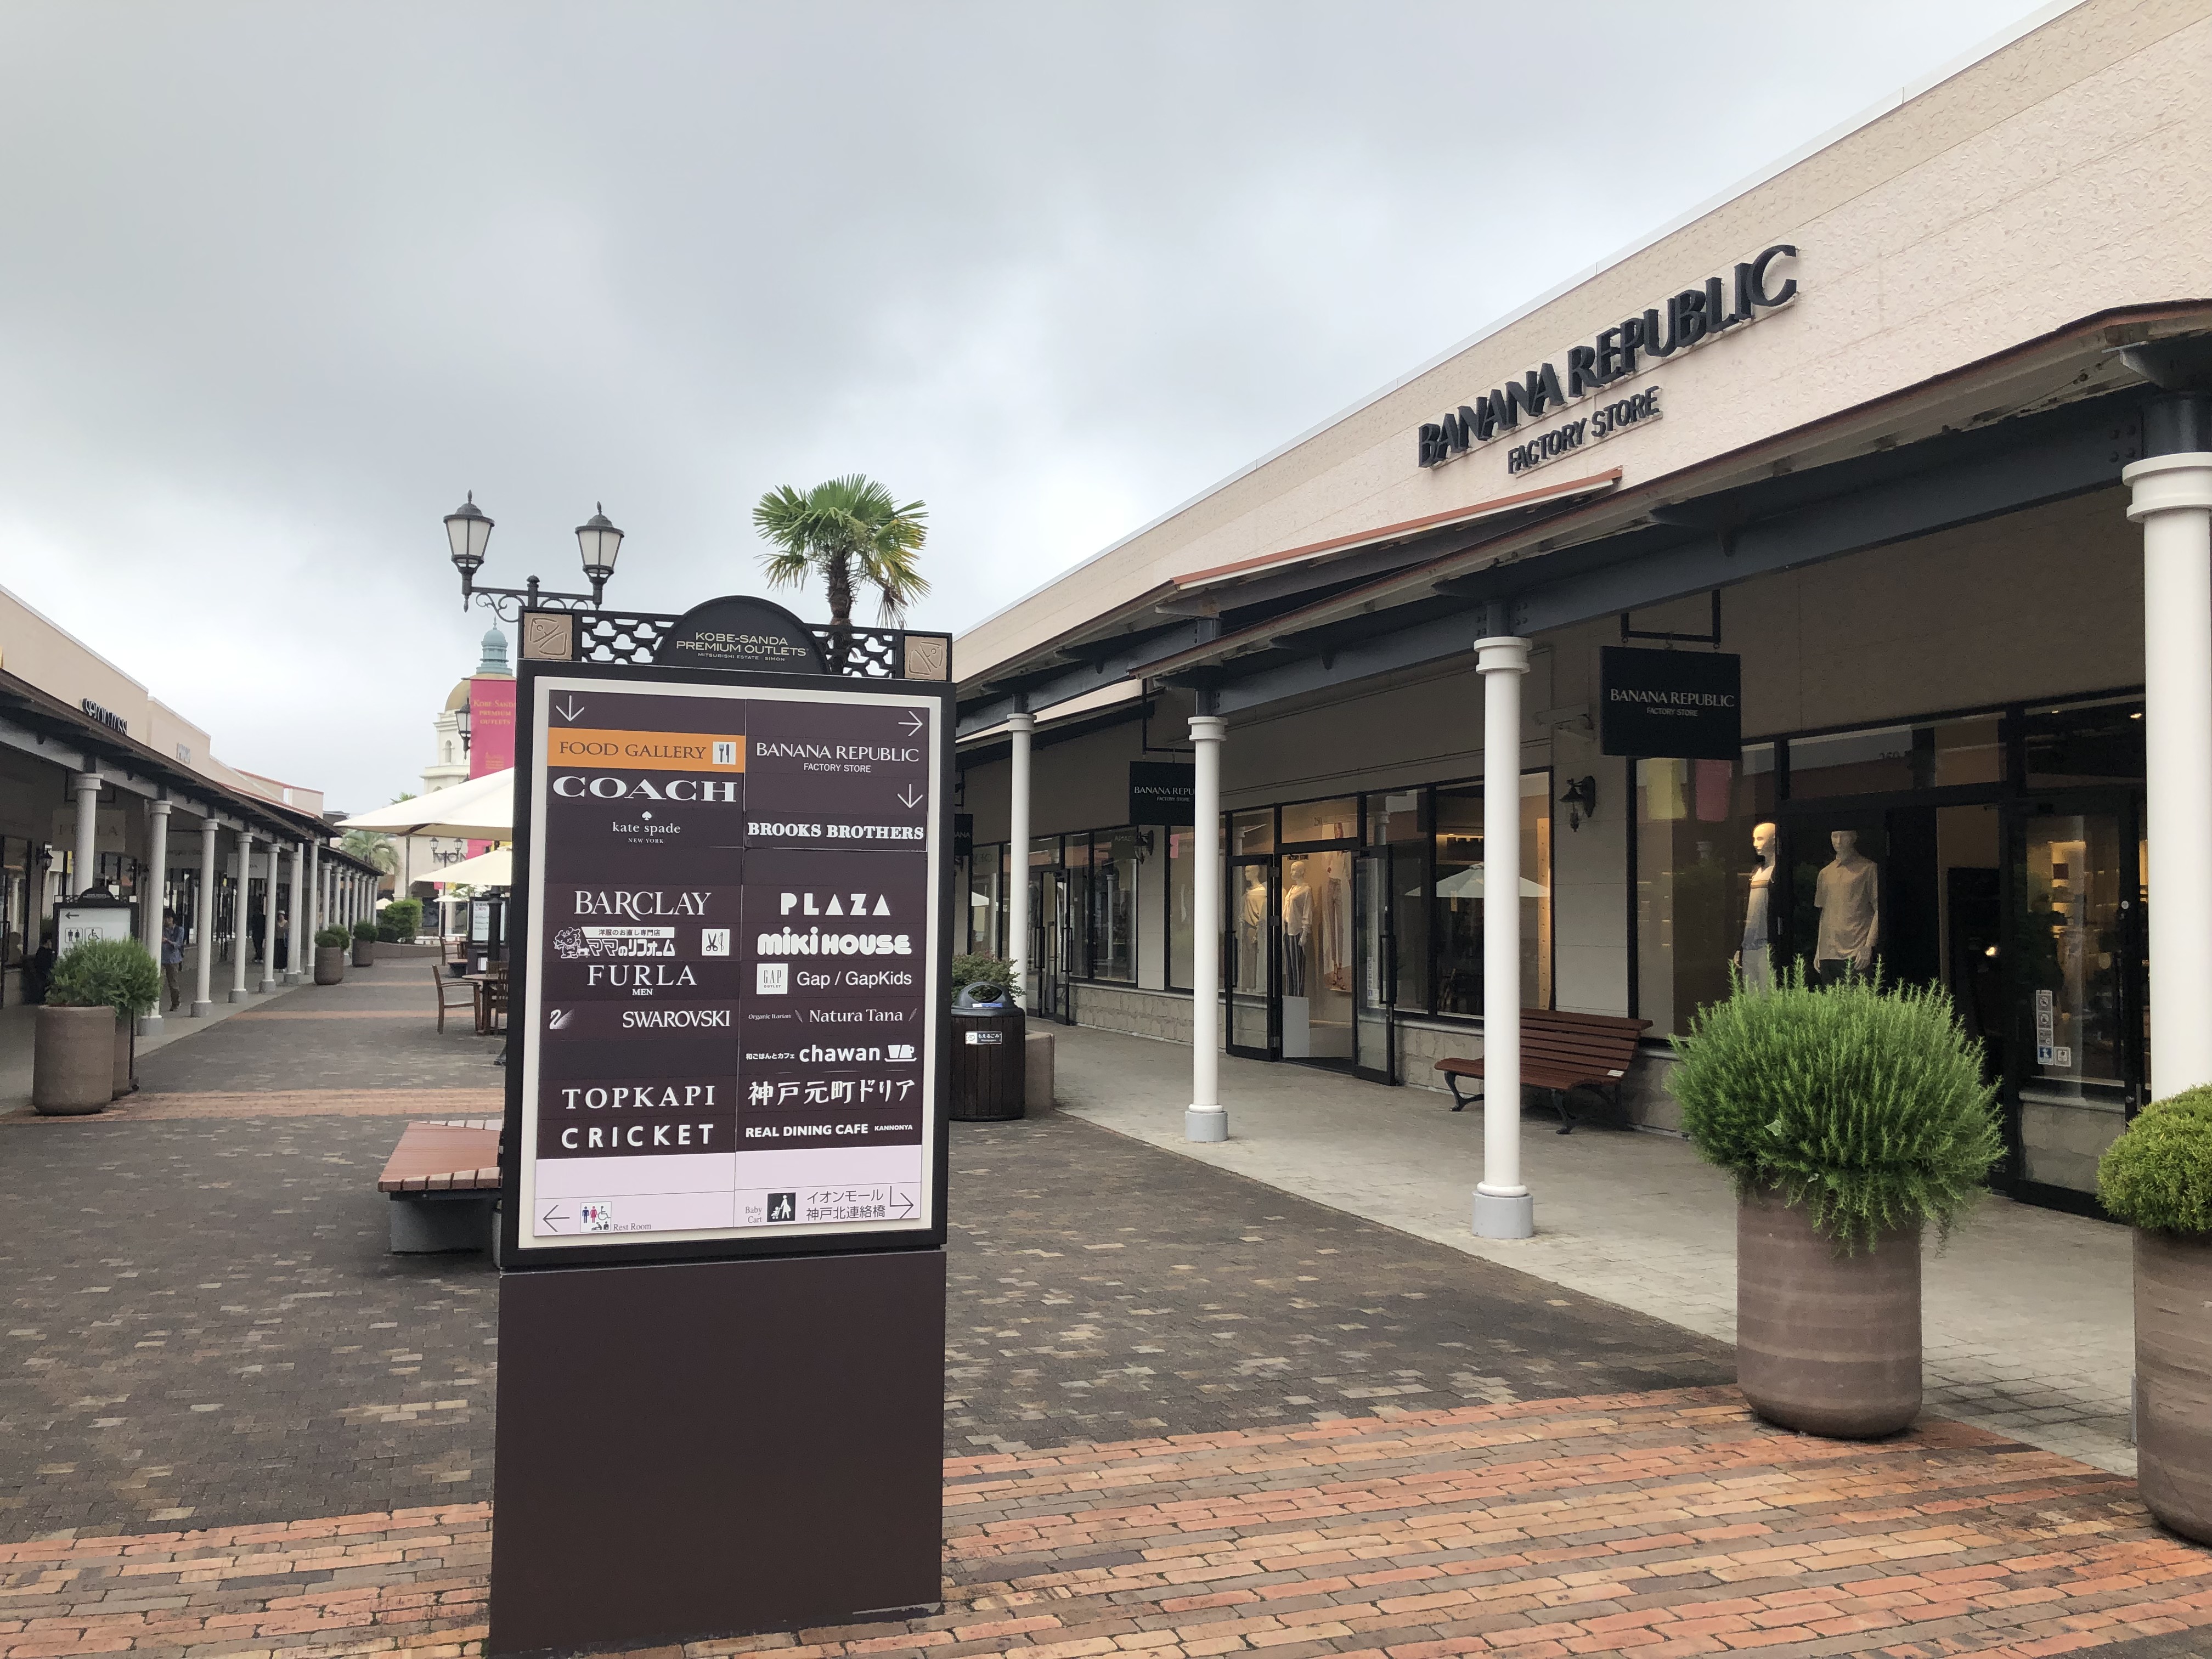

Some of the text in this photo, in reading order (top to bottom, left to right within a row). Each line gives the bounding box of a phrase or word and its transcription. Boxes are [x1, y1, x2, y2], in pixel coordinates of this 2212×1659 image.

[1419, 245, 1798, 468] BANANA REPUBLIC
[1508, 385, 1661, 475] FACTORY STORE
[676, 641, 741, 652] PREMIUM
[696, 632, 788, 646] KOBE-SANDA
[1610, 689, 1735, 707] BANANA REPUBLIC
[1646, 707, 1699, 716] FACTORY STORE
[560, 742, 707, 759] FOOD GALLERY
[757, 742, 919, 762] BANANA REPUBLIC
[804, 763, 871, 773] FACTORY STORE
[553, 776, 737, 802] COACH
[1134, 786, 1170, 794] BANANA
[612, 822, 681, 836] kate spade
[748, 822, 924, 840] BROOKS BROTHERS
[574, 890, 712, 921] BARCLAY
[781, 893, 891, 916] PLAZA
[586, 939, 675, 957] ママのリフォーム
[821, 934, 912, 955] HOUSE
[587, 965, 697, 986] FURLA
[763, 969, 782, 984] GAP
[797, 971, 830, 989] Gap
[845, 970, 912, 989] GapKids
[622, 1010, 731, 1028] SWAROVSKI
[809, 1009, 863, 1023] Natura
[865, 1009, 904, 1022] Tana
[799, 1045, 881, 1062] chawan
[562, 1085, 715, 1109] TOPKAPI
[747, 1079, 915, 1106] 神戸元町ドリア
[561, 1124, 713, 1149] CRICKET
[746, 1126, 779, 1138] REAL
[783, 1125, 832, 1137] DINING
[835, 1124, 868, 1135] CAFE
[806, 1189, 884, 1204] イオンモール
[745, 1206, 762, 1215] Baby
[806, 1205, 885, 1221] 神戸北連絡橋
